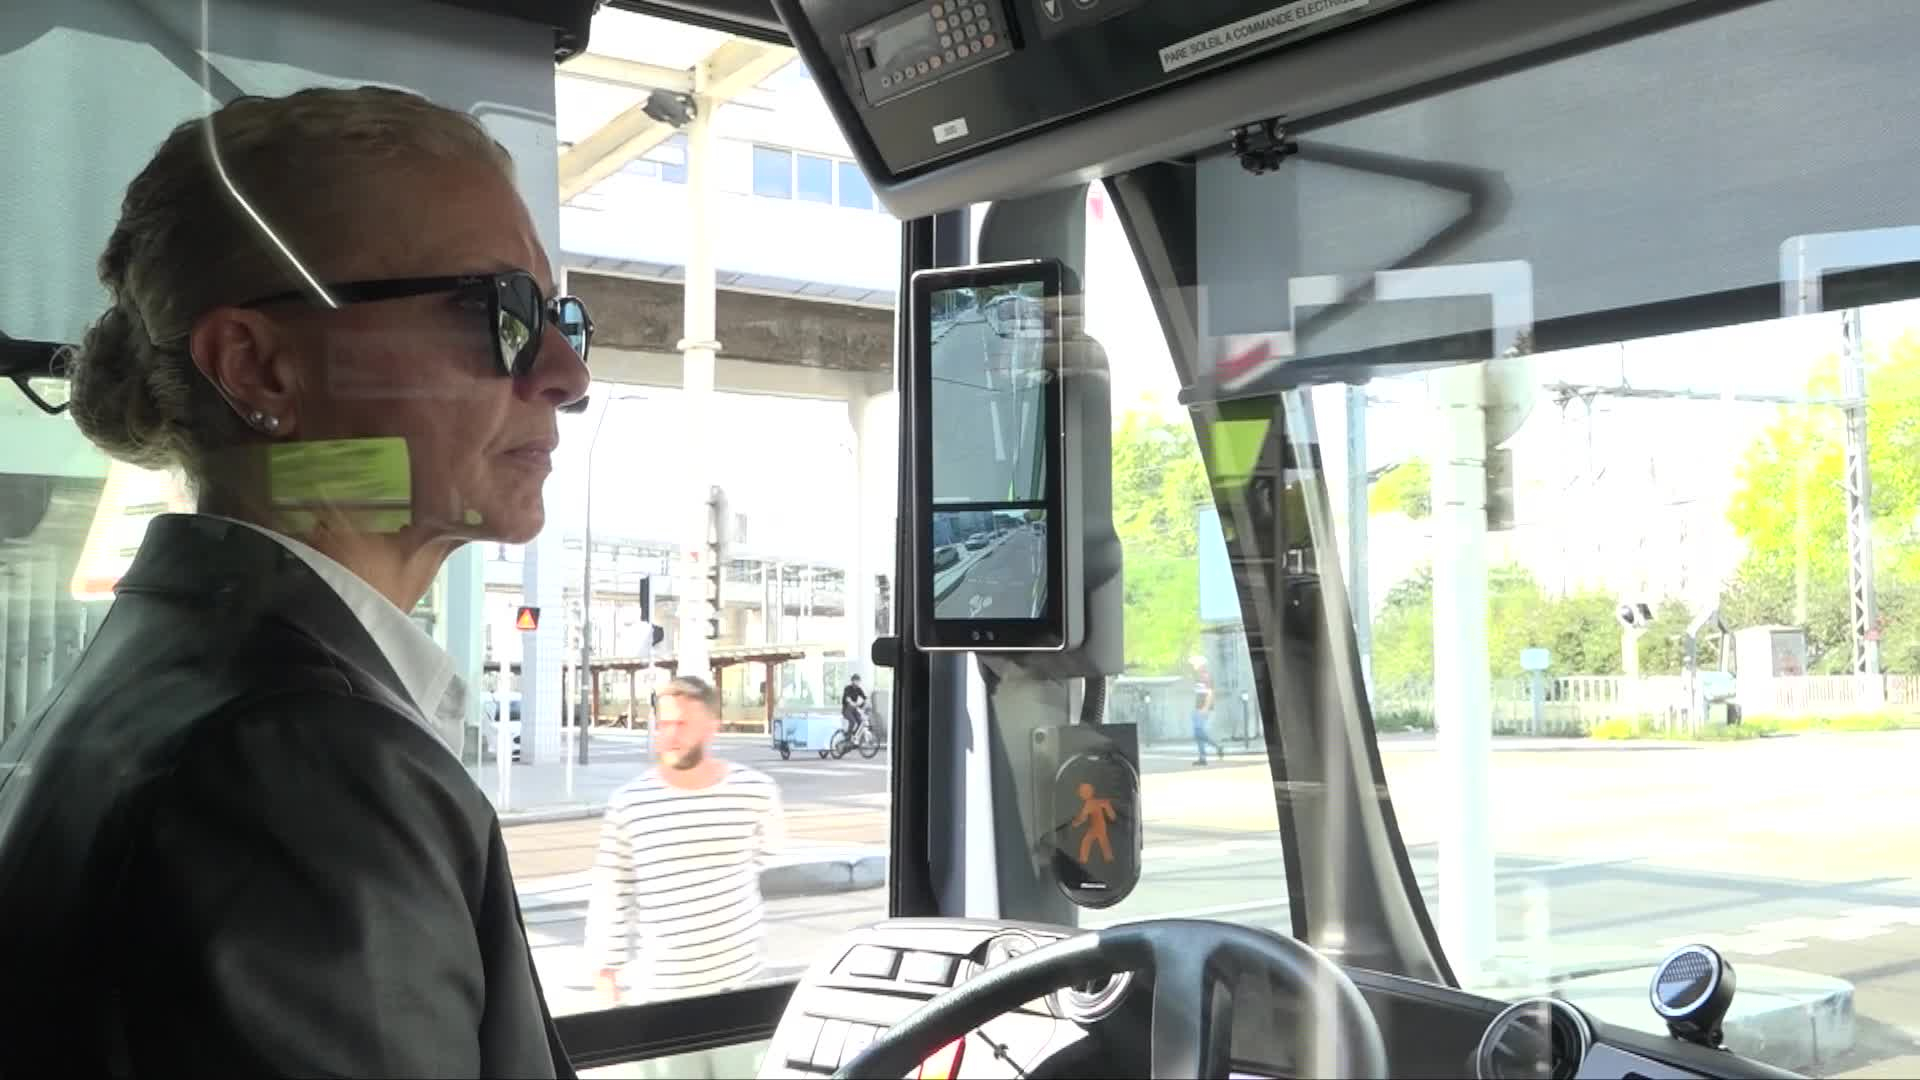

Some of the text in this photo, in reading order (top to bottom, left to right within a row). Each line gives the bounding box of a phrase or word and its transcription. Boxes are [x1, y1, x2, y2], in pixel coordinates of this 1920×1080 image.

[1164, 48, 1188, 64] PARE
[1190, 37, 1224, 56] SOLEIL
[1225, 32, 1233, 43] A
[1233, 10, 1296, 40] COMMANDE
